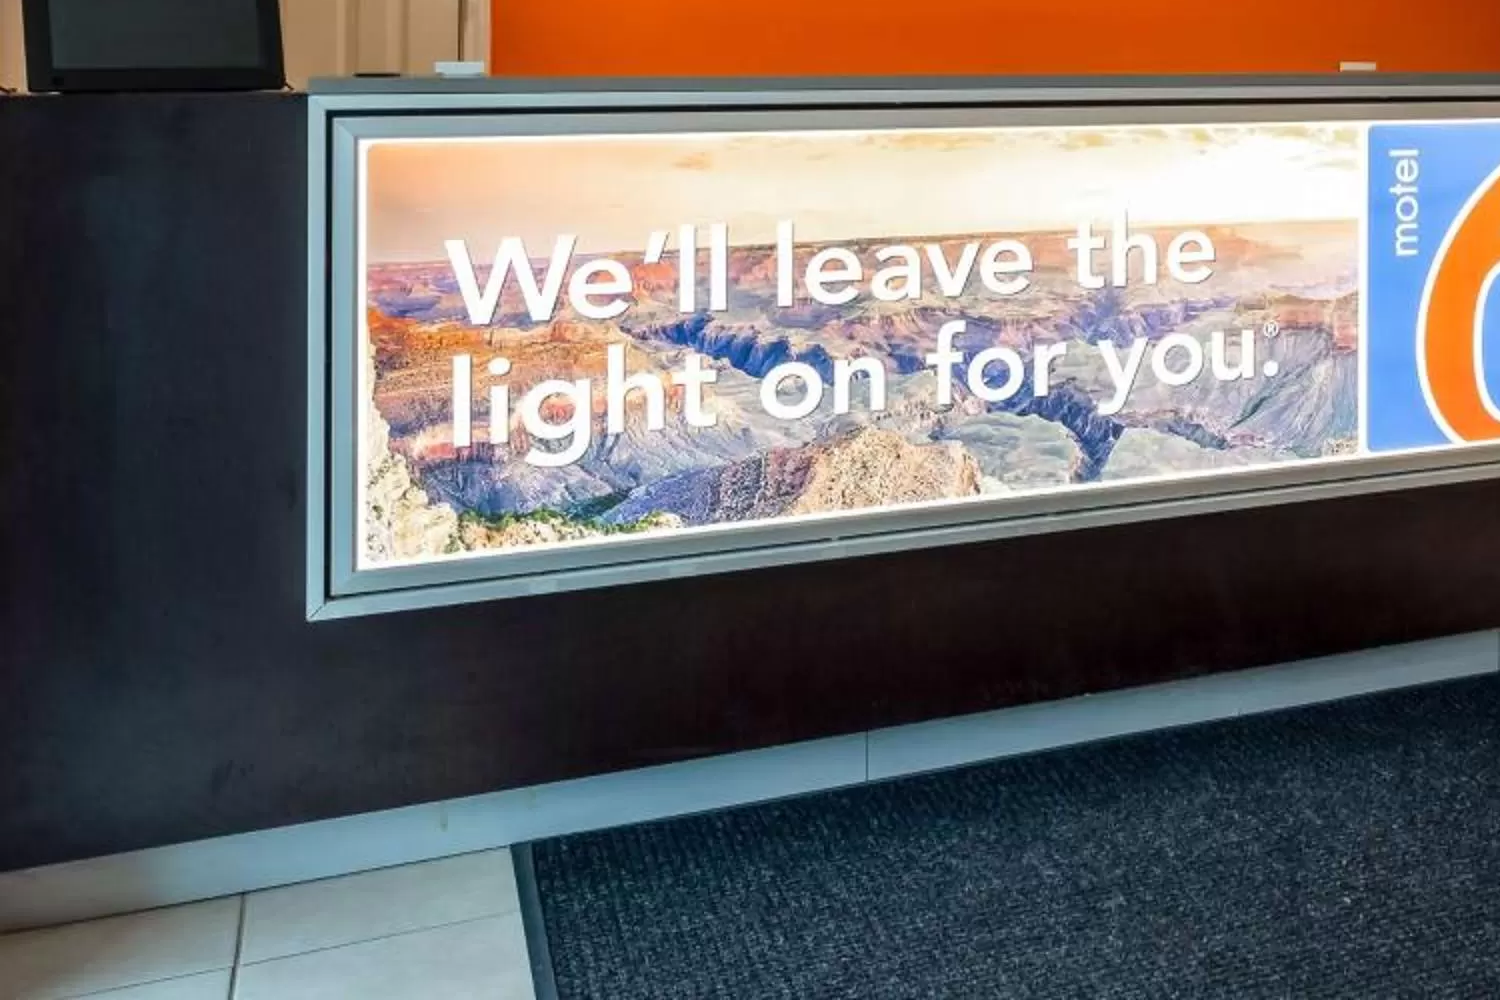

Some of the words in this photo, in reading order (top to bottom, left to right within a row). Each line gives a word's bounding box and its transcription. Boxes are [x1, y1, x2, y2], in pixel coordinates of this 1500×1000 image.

[1388, 149, 1420, 256] motel
[444, 220, 729, 325] We'll
[776, 219, 1034, 308] leave
[1066, 206, 1216, 290] the
[451, 343, 717, 468] light
[759, 355, 886, 420] on
[924, 318, 1067, 406] for
